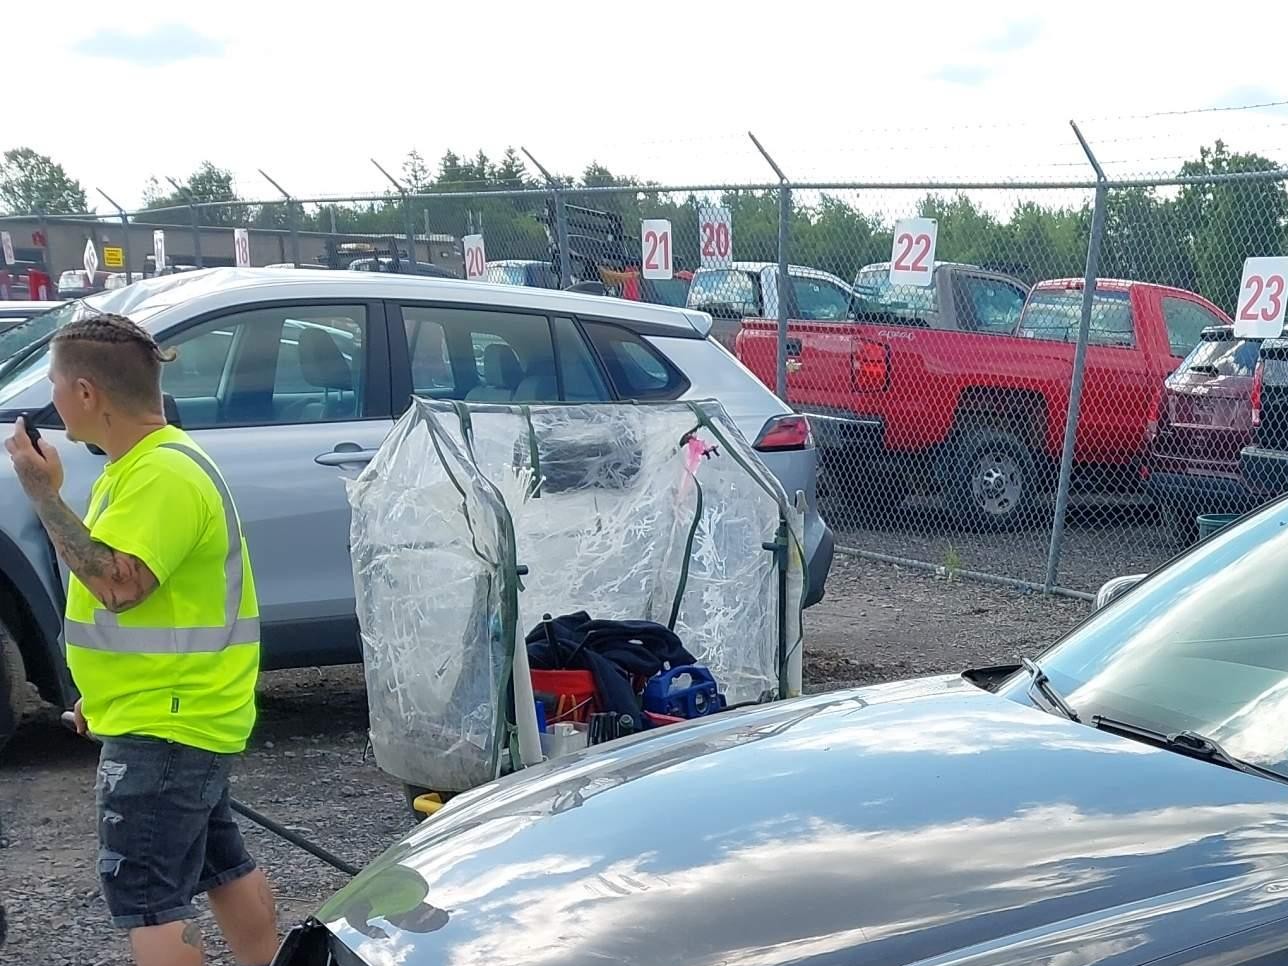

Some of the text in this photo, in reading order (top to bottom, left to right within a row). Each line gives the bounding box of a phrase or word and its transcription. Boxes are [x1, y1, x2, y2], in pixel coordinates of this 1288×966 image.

[236, 238, 248, 264] 18
[645, 231, 671, 270] 21
[703, 222, 729, 258] 20
[894, 233, 932, 274] 22
[466, 247, 484, 276] 20
[1240, 275, 1284, 322] 23
